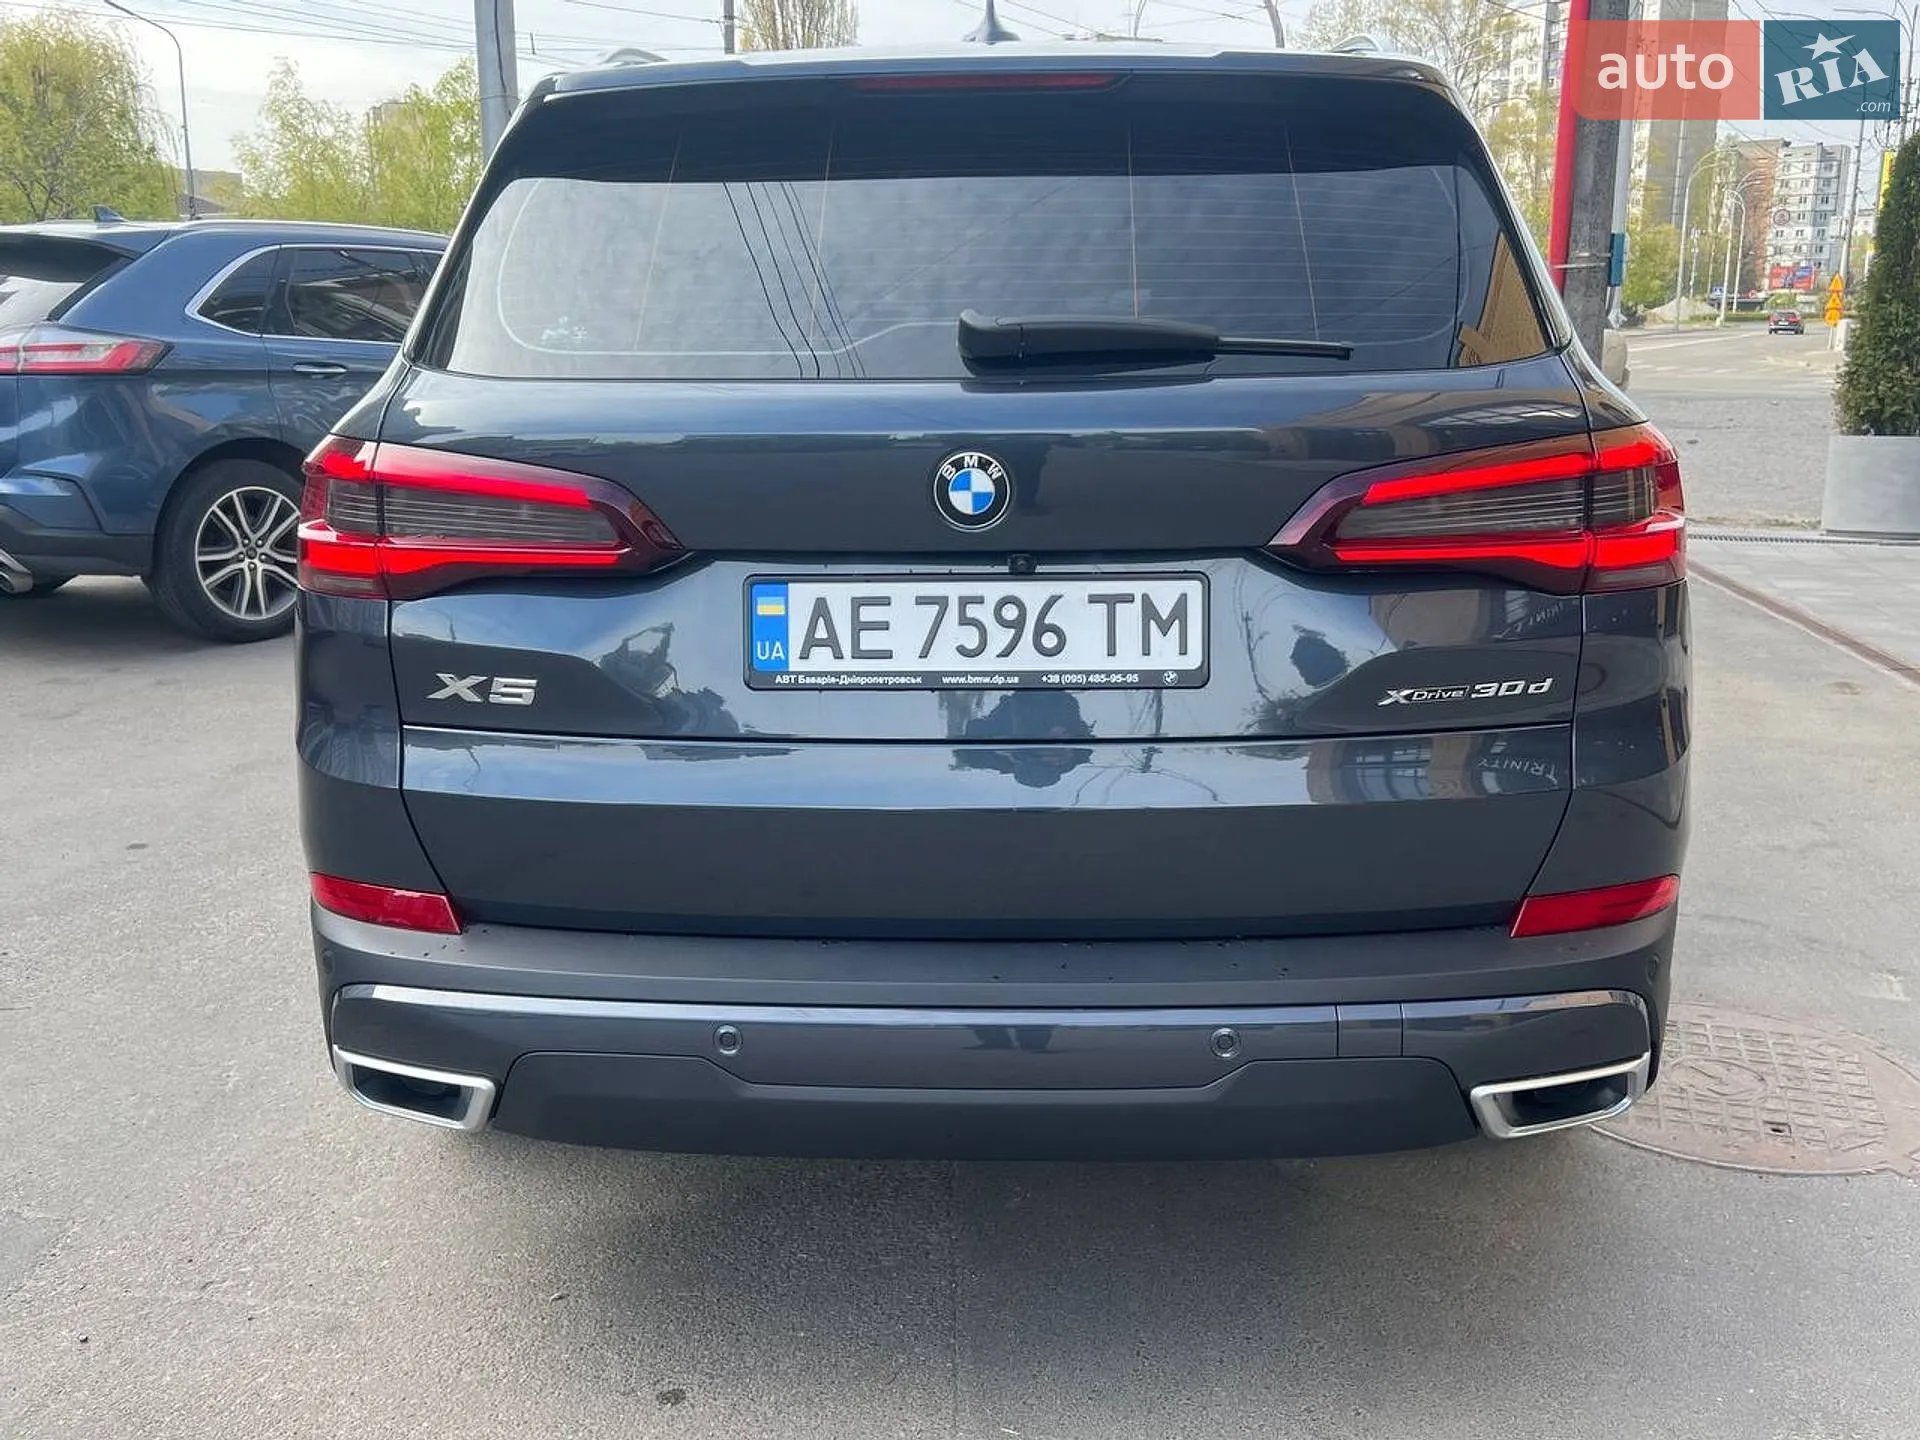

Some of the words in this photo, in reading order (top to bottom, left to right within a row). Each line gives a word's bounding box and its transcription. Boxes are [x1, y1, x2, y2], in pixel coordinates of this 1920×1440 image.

[941, 455, 1002, 481] BMW
[799, 596, 894, 660] AE
[915, 594, 1067, 659] 7596
[1087, 592, 1188, 657] TM
[756, 640, 785, 661] UA
[425, 672, 538, 706] X5
[942, 674, 1020, 685] www.bmw.dp.ua
